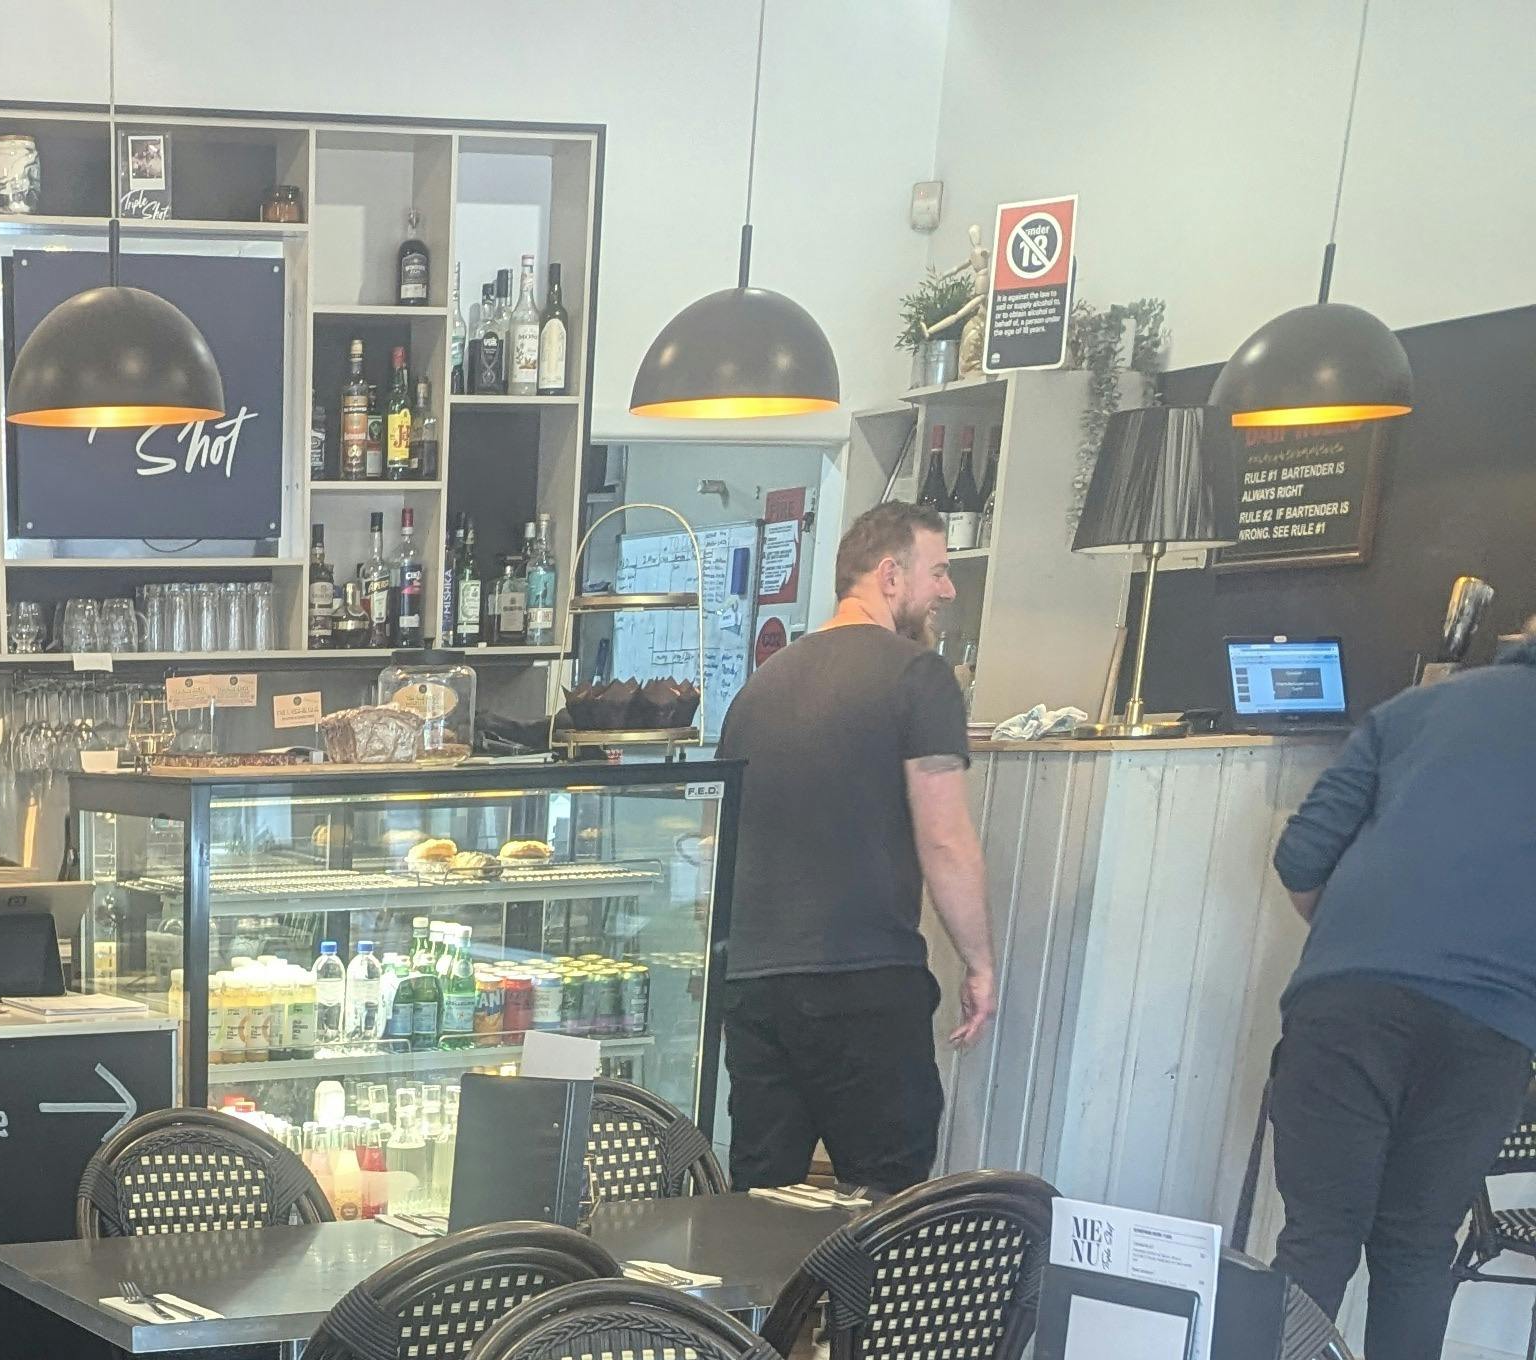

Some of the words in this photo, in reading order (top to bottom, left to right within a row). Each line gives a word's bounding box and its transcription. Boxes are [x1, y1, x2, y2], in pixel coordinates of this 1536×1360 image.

[1019, 235, 1048, 267] 18
[1008, 293, 1029, 302] against
[136, 406, 258, 478] Shot
[1244, 470, 1266, 484] RULE
[1268, 469, 1278, 480] #1
[1281, 462, 1334, 480] BARTENDER
[1335, 461, 1345, 474] IS
[1241, 486, 1276, 502] ALWAYS
[1277, 484, 1304, 499] RIGHT
[1239, 511, 1261, 523] RULE
[1262, 509, 1272, 521] #2
[1275, 508, 1284, 520] IF
[1285, 502, 1338, 520] BARTENDER
[1339, 501, 1350, 514] IS
[1272, 525, 1290, 539] SEE
[1291, 522, 1314, 536] RULE
[1315, 521, 1326, 534] #1
[1072, 1215, 1102, 1242] ME
[1070, 1239, 1100, 1266] NU
